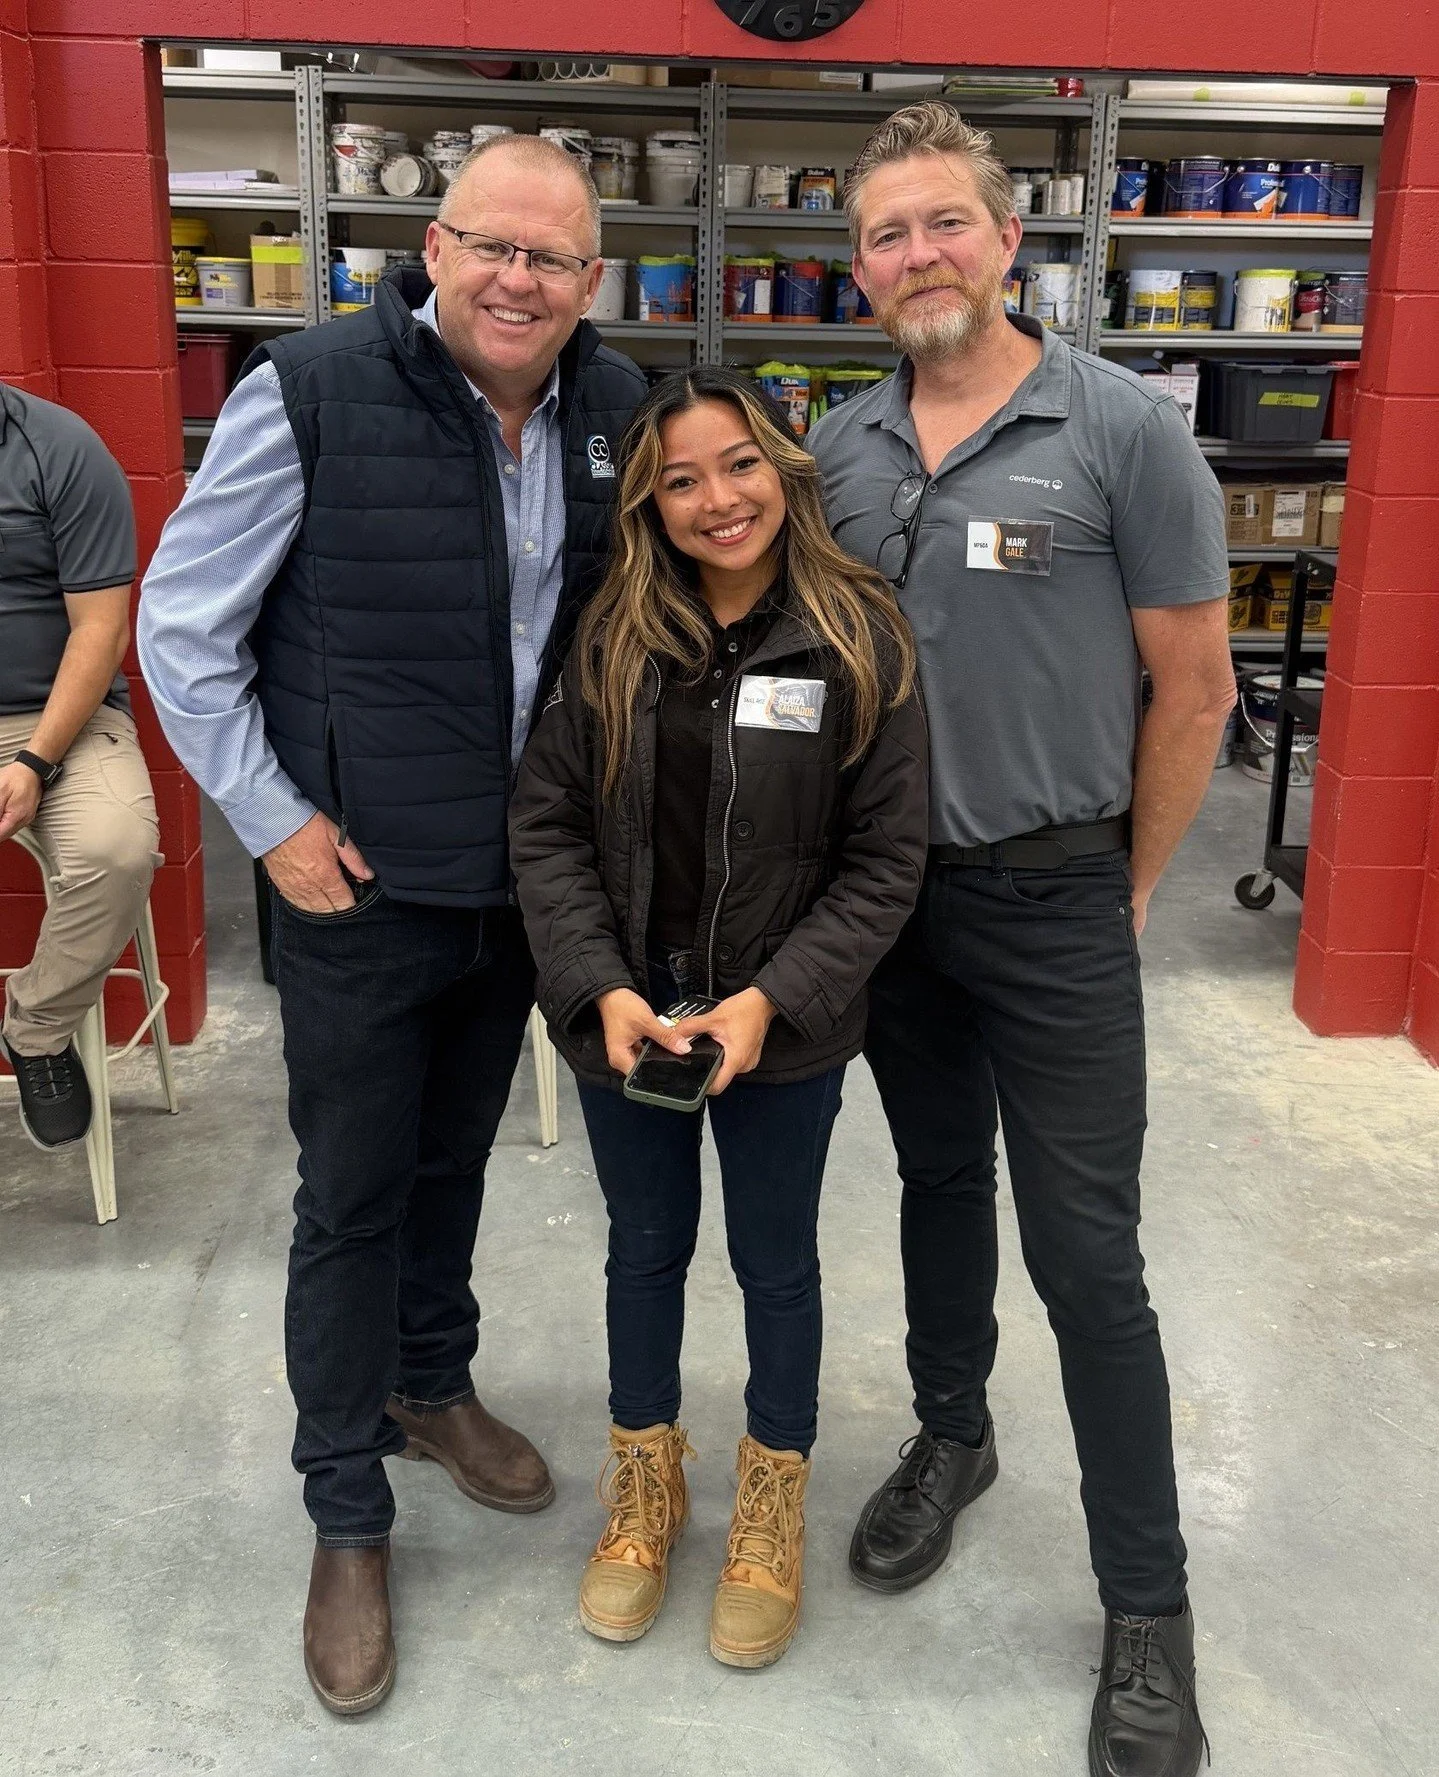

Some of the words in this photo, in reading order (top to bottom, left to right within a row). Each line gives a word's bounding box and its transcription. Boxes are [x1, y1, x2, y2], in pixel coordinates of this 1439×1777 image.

[738, 0, 767, 26] 7
[773, 4, 804, 38] 6
[811, 0, 841, 28] 5
[1009, 474, 1051, 488] cederberg
[1005, 537, 1028, 548] MARK
[1005, 547, 1025, 557] GALE
[777, 703, 815, 718] SALVADOR
